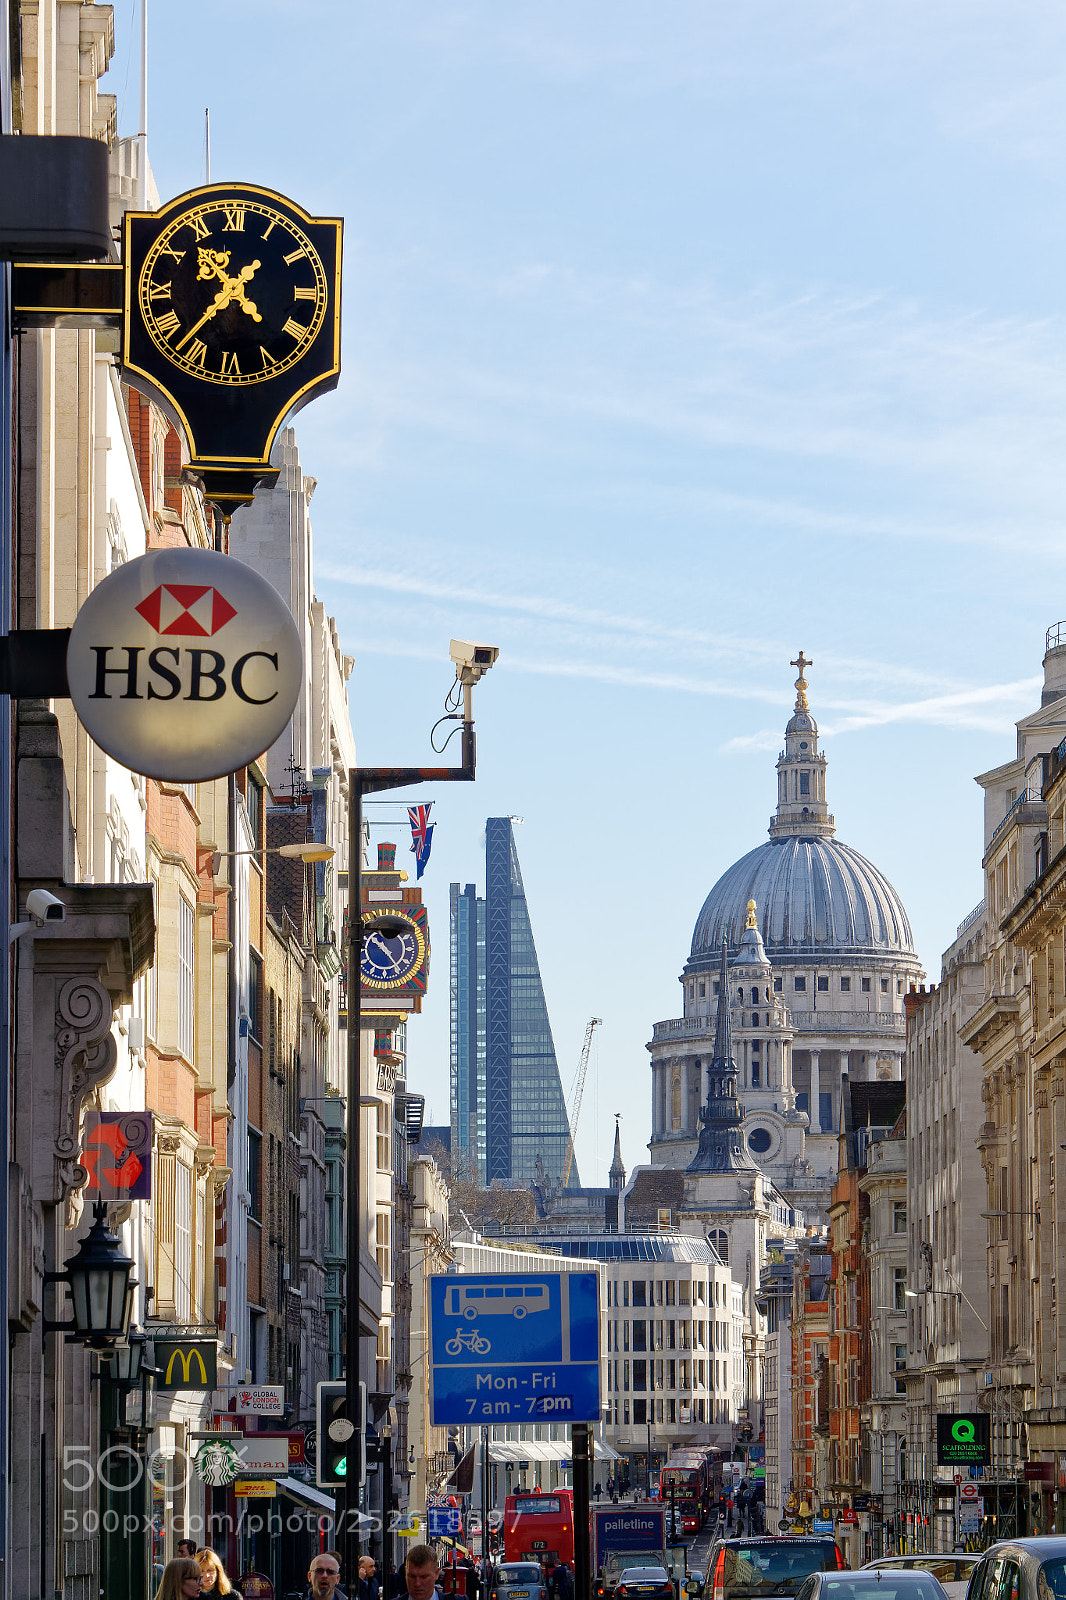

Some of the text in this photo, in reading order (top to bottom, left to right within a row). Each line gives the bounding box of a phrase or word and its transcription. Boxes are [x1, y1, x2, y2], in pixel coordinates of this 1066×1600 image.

[187, 216, 213, 242] XI
[222, 210, 246, 232] XII
[260, 219, 279, 242] I
[161, 241, 187, 265] X
[282, 245, 308, 267] II
[150, 280, 172, 302] IX
[294, 285, 317, 302] III
[183, 337, 209, 369] VII
[219, 351, 242, 375] VI
[259, 345, 279, 369] V
[88, 646, 279, 705] HSBC
[951, 1419, 976, 1443] Q
[239, 1460, 286, 1470] yman
[604, 1518, 655, 1533] palletline
[533, 1541, 545, 1549] 172
